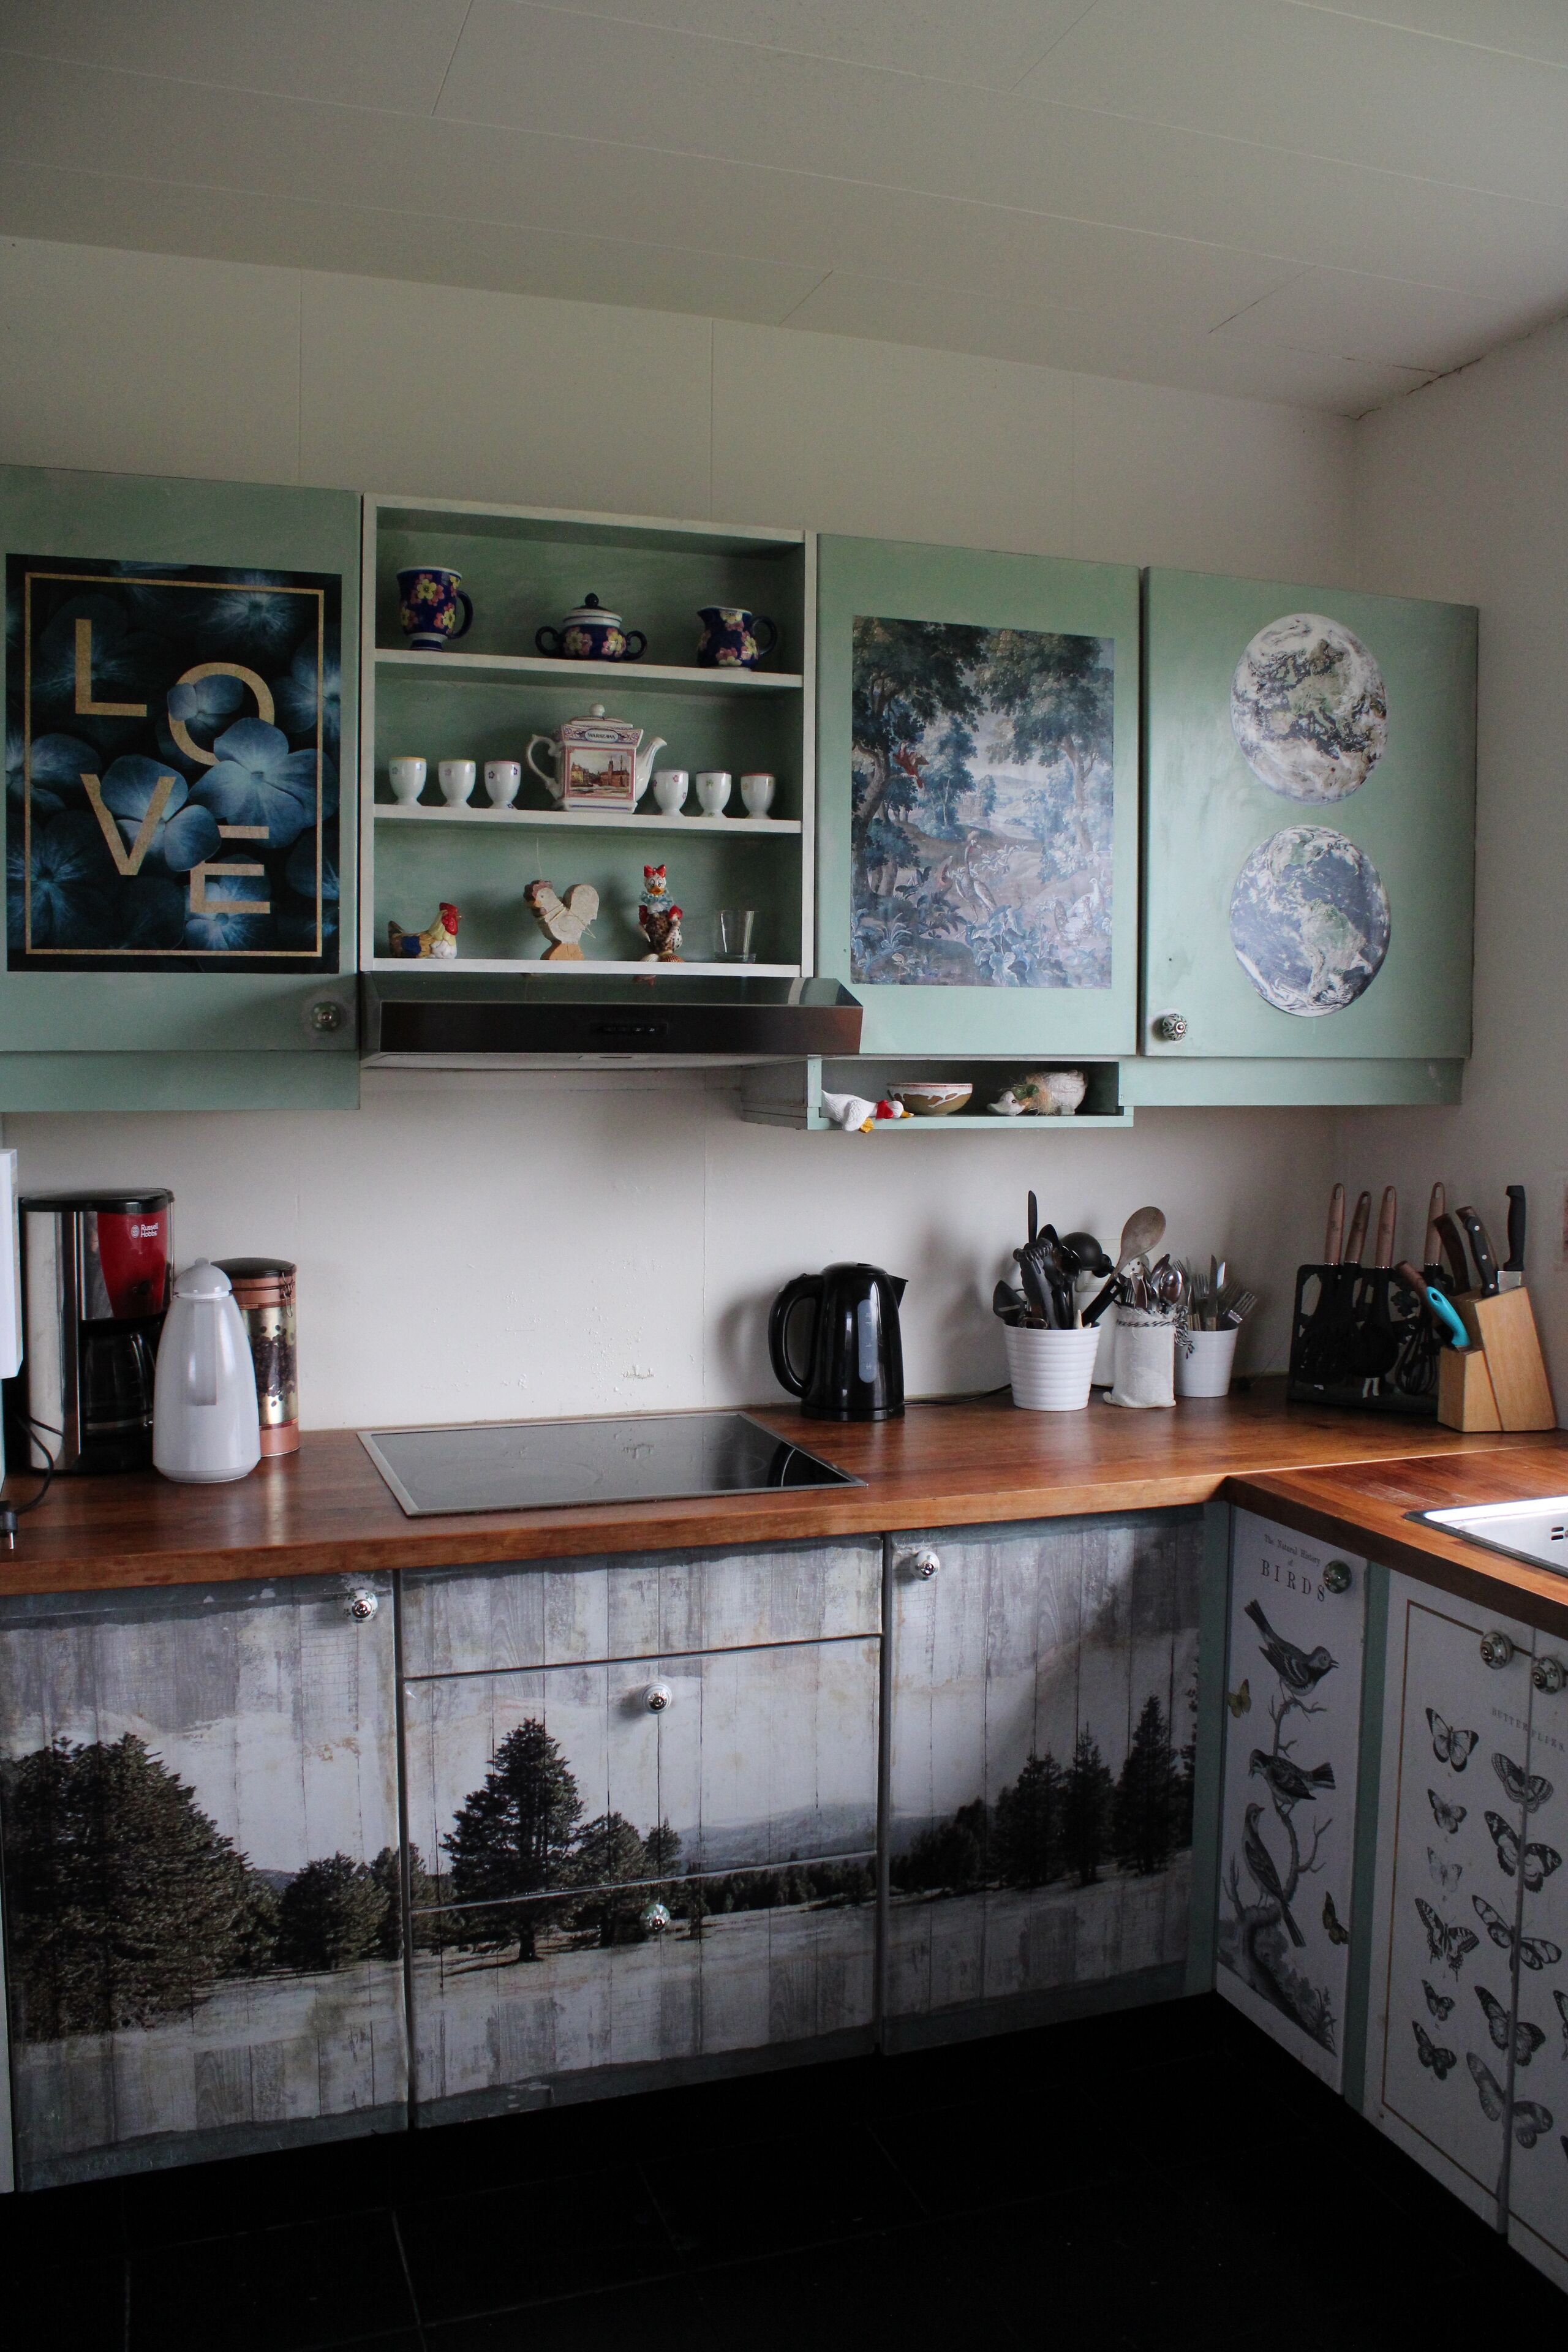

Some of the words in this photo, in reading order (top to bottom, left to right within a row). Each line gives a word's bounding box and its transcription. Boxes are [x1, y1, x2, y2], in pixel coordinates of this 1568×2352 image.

[141, 1222, 159, 1231] Russell
[141, 1229, 157, 1238] Hobbs
[1264, 1534, 1275, 1545] The
[1277, 1539, 1297, 1555] Natural
[1300, 1548, 1321, 1567] History
[1260, 1558, 1325, 1602] BIRDS
